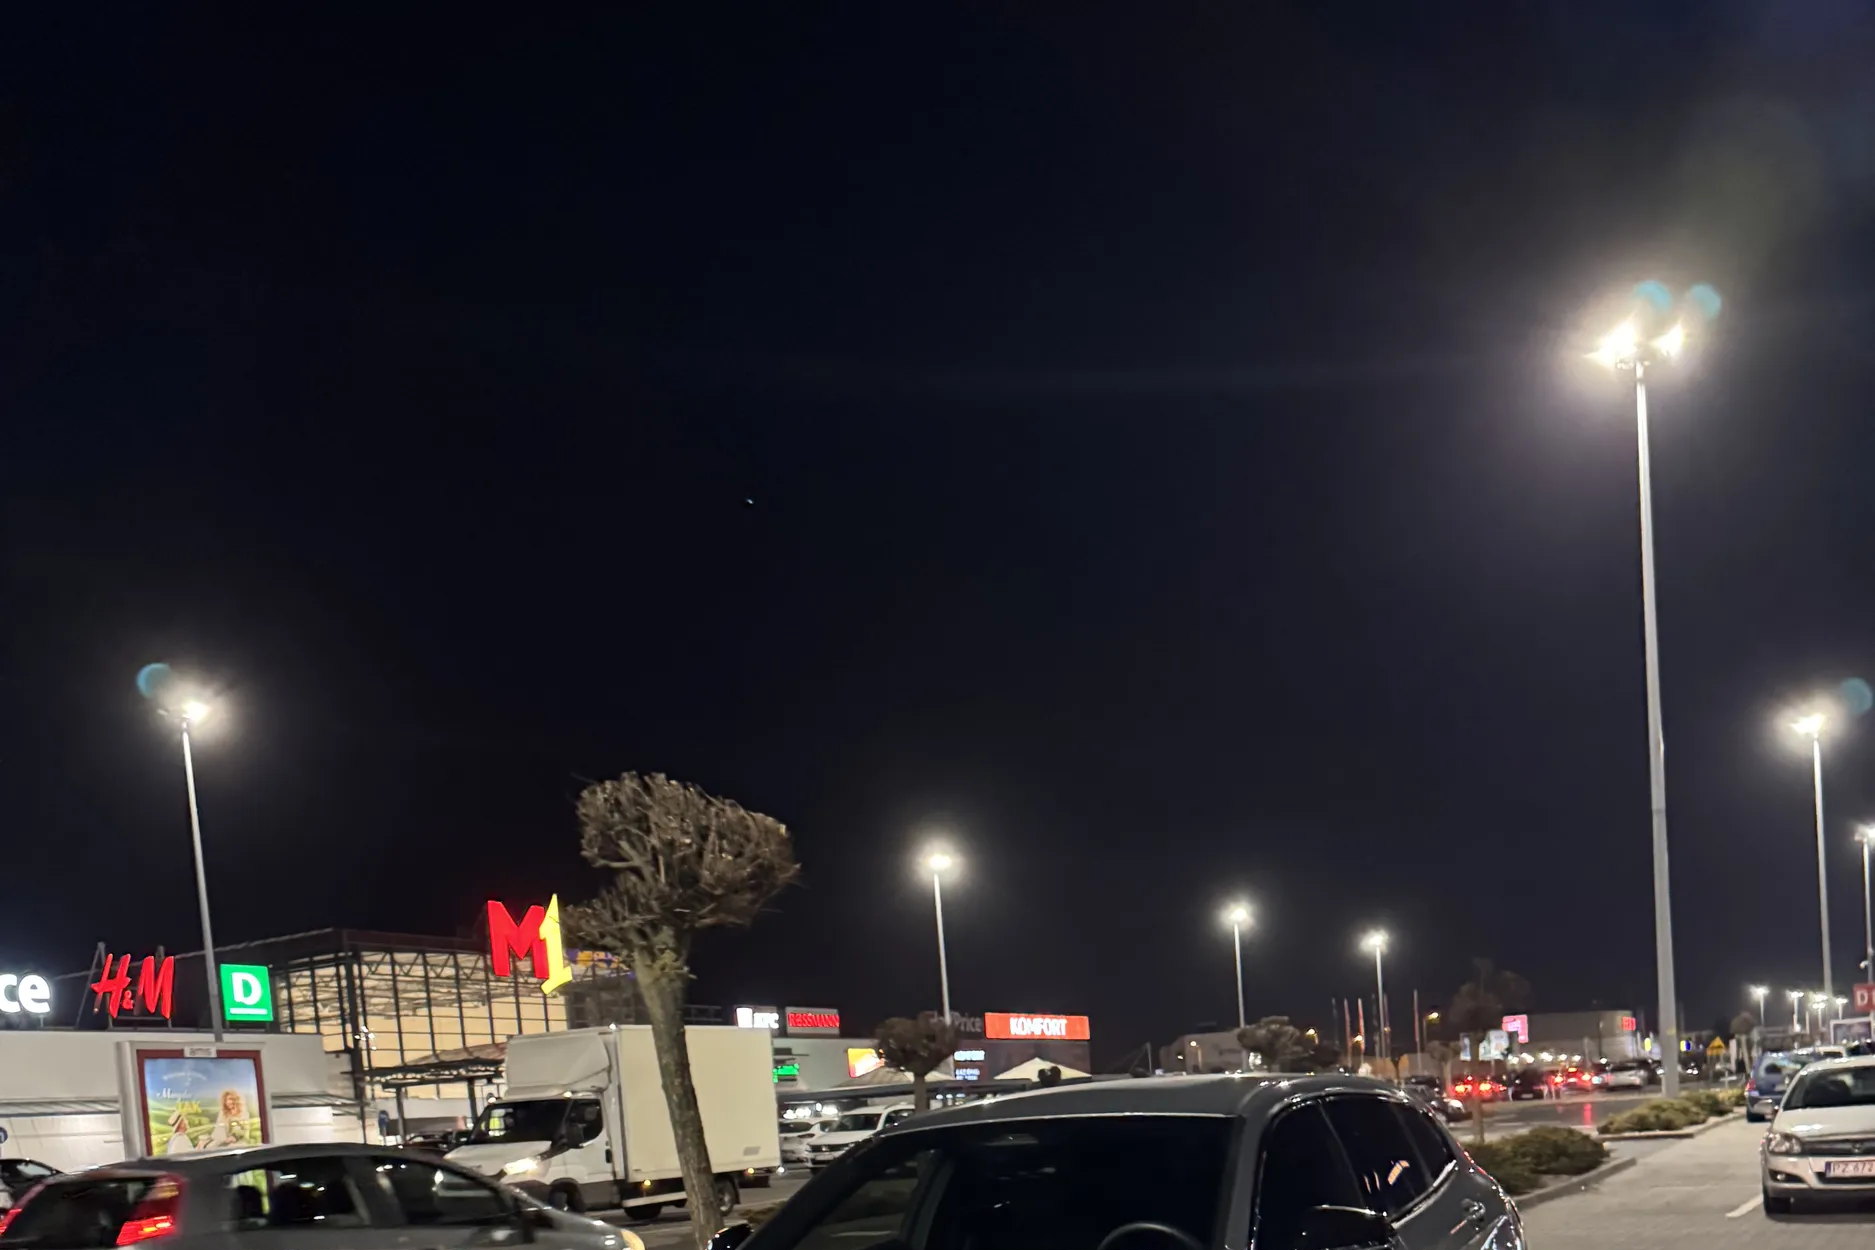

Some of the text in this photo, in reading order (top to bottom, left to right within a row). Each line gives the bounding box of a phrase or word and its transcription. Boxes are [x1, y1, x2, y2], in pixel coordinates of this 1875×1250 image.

[488, 894, 573, 995] M1
[91, 953, 175, 1019] H&M
[231, 972, 262, 1005] D
[1009, 1016, 1067, 1036] KOMFORT
